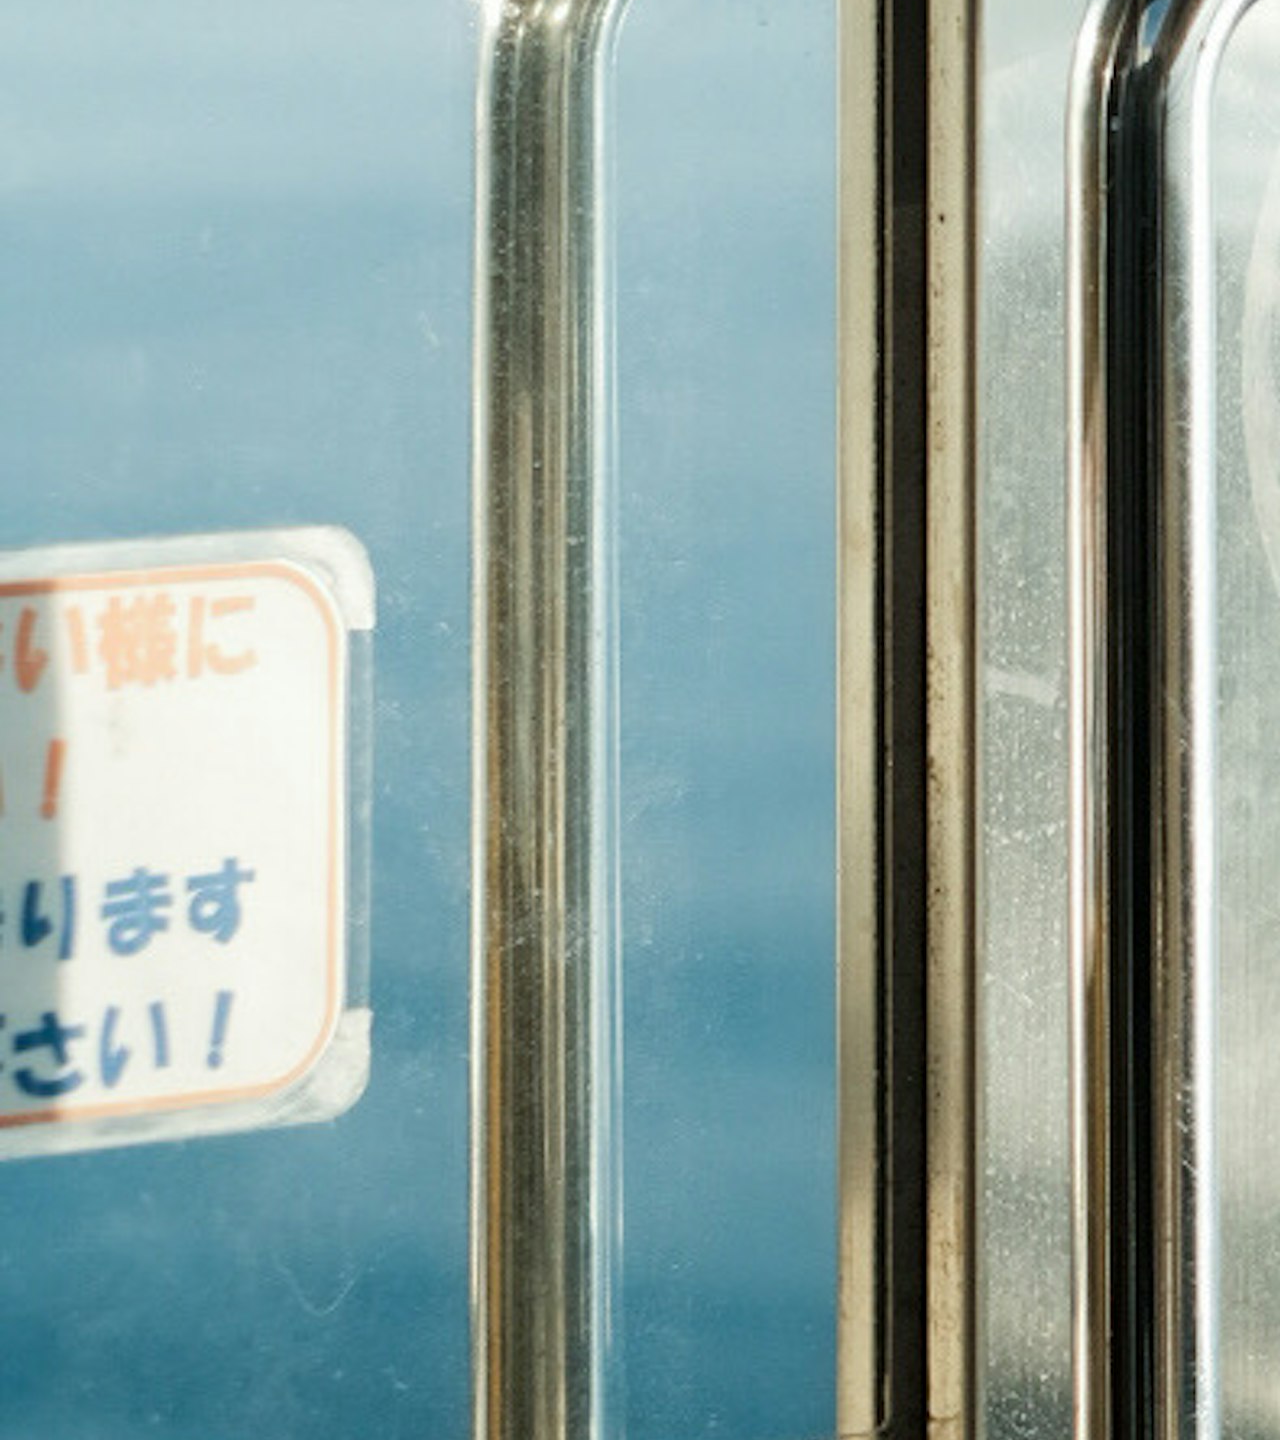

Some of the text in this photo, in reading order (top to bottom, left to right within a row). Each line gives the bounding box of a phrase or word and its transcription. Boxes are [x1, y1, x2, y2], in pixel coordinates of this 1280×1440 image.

[0, 593, 257, 692] い様に
[0, 858, 256, 961] ります
[0, 991, 234, 1097] さい!
